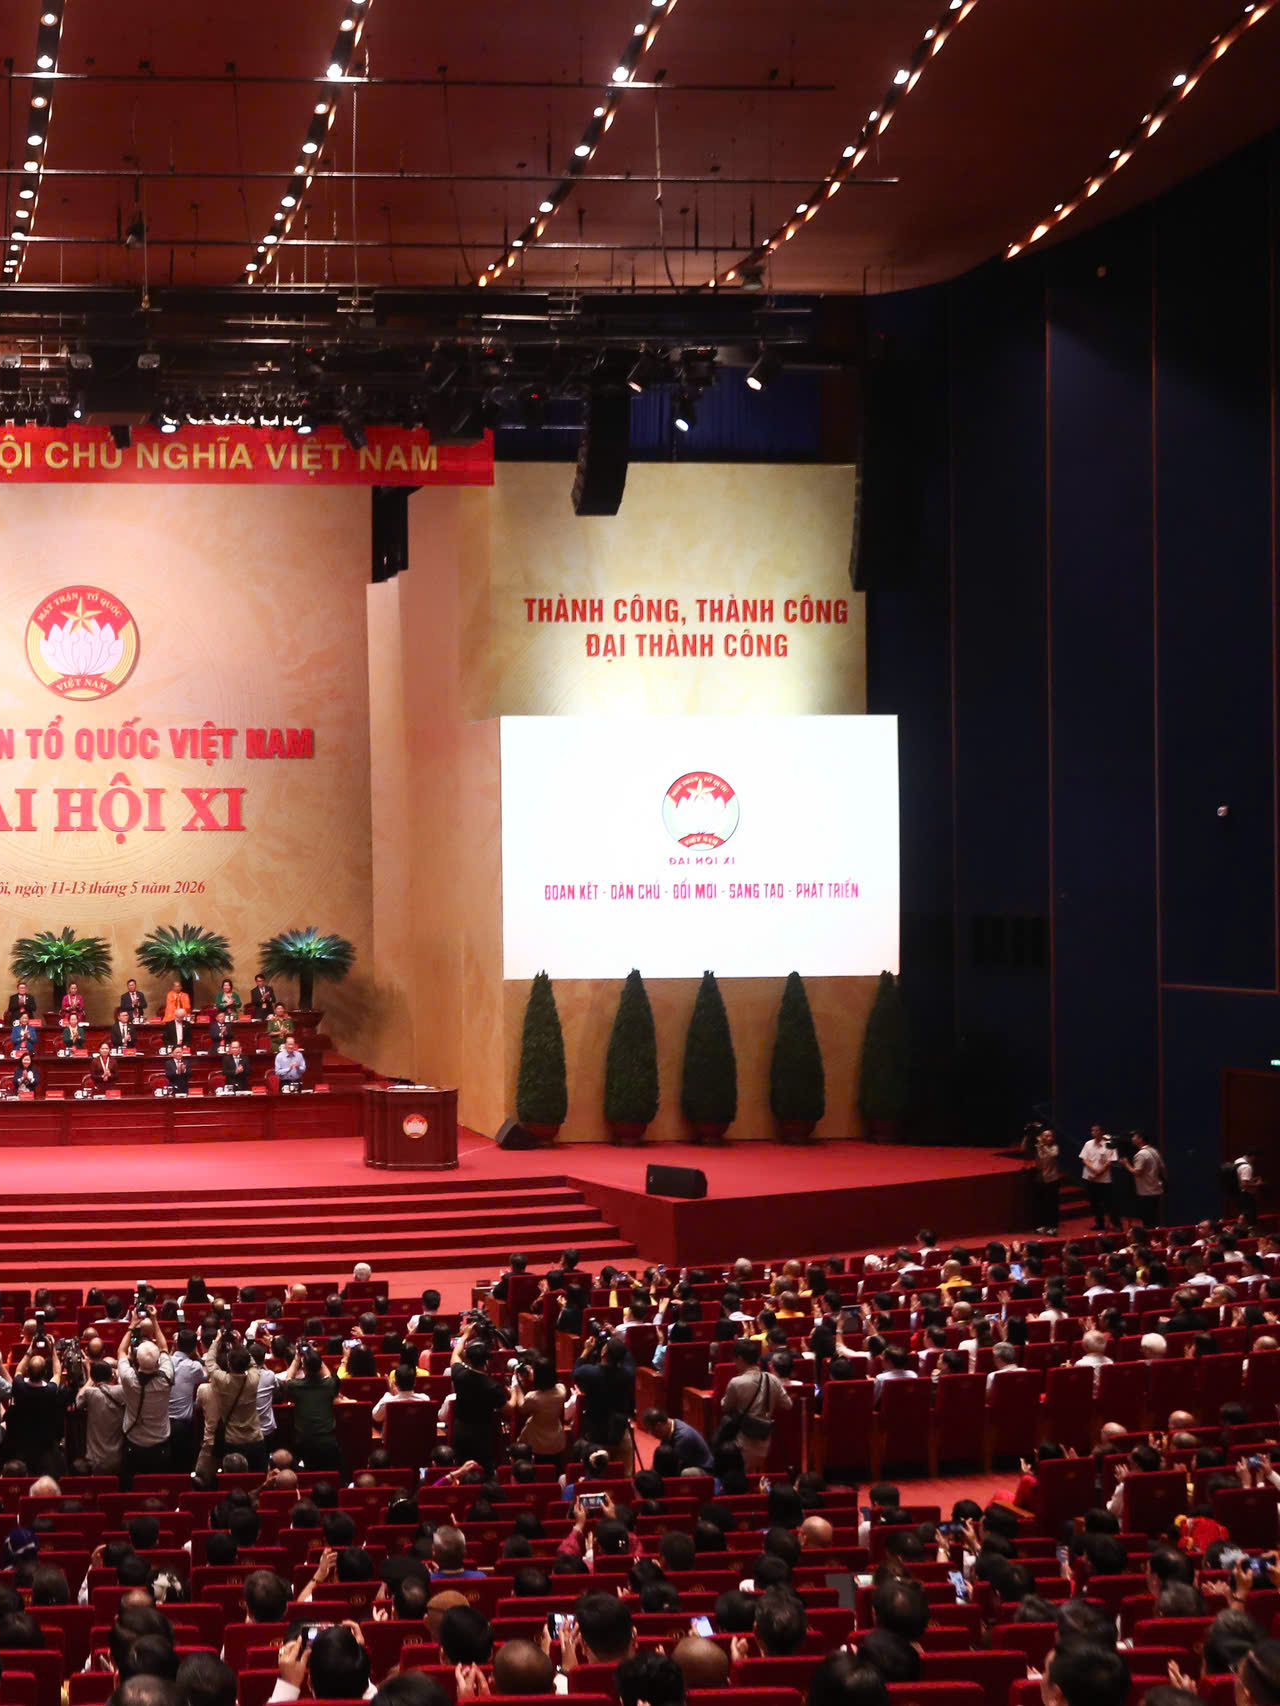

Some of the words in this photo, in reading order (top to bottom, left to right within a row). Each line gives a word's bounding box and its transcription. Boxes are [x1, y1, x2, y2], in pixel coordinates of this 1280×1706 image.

[136, 436, 253, 470] NGHĨA
[265, 437, 347, 476] VIỆT
[359, 444, 439, 472] NAM
[524, 593, 604, 623] THÀNH
[613, 594, 687, 626] CÔNG,
[695, 593, 774, 623] THÀNH
[783, 594, 848, 624] CÔNG
[585, 633, 626, 662] ĐẠI
[635, 628, 713, 657] THÀNH
[724, 628, 788, 657] CÔNG
[85, 679, 108, 692] NAM
[25, 714, 64, 760] TỔ
[74, 718, 160, 762] QUỐC
[169, 720, 236, 767] VIỆT
[245, 728, 315, 760] NAM
[53, 771, 167, 845] HỘI
[182, 787, 248, 832] XI
[14, 883, 47, 898] ngày
[50, 881, 85, 895] 11-13
[88, 880, 128, 898] tháng
[130, 881, 138, 894] 5
[141, 882, 170, 894] năm
[173, 880, 206, 894] 2026
